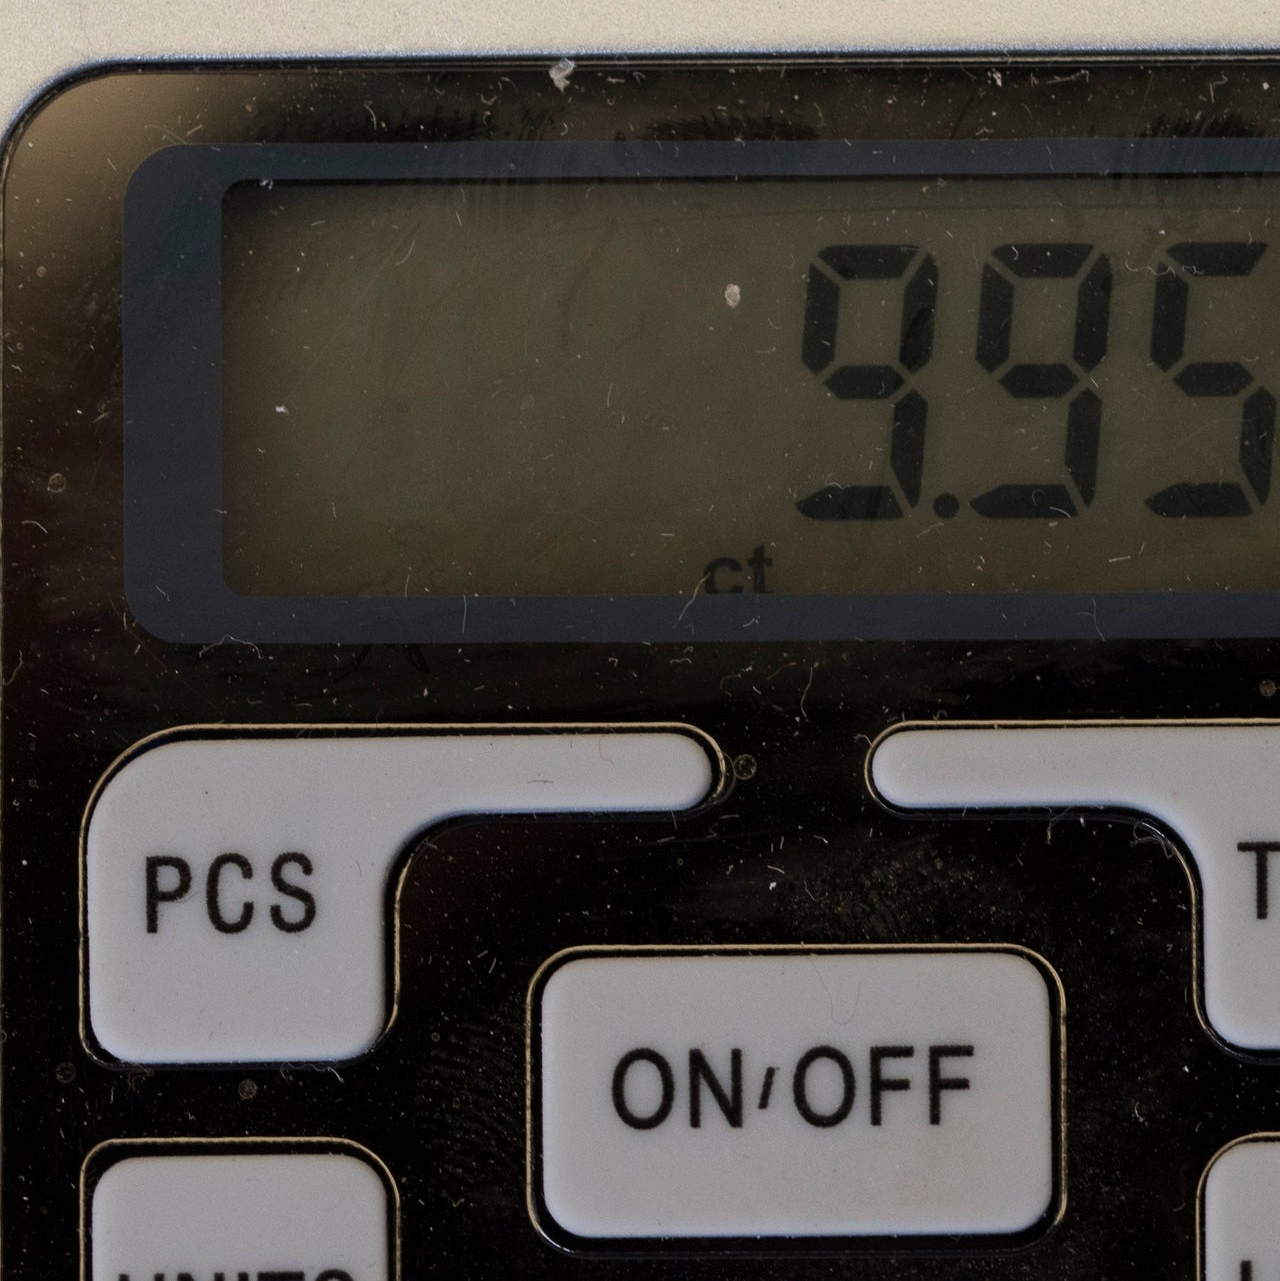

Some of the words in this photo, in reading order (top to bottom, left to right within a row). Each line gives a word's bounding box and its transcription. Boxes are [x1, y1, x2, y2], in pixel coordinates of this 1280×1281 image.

[793, 240, 1278, 521] 9.95
[702, 543, 774, 594] ct
[144, 851, 317, 935] PCS
[611, 1044, 975, 1130] ON/OFF
